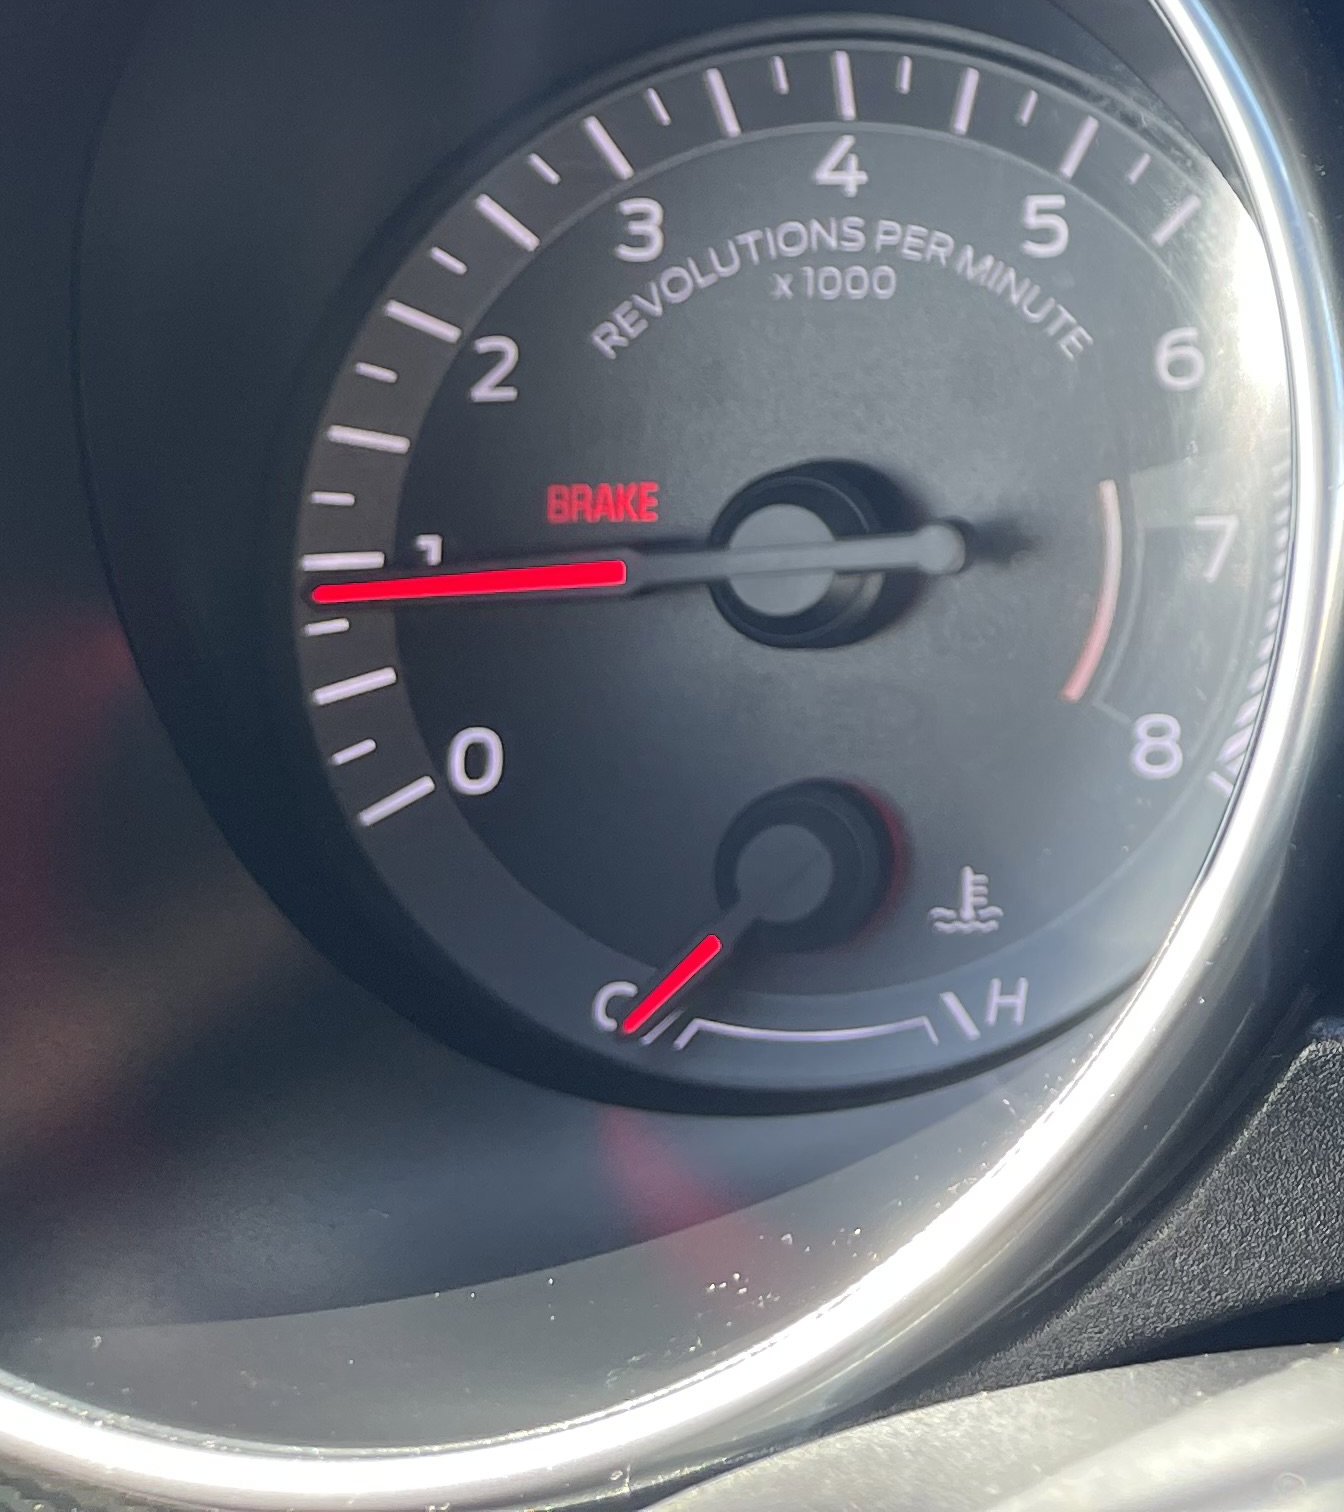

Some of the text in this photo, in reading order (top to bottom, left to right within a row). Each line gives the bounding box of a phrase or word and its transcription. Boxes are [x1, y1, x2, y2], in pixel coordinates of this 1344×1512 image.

[815, 135, 868, 196] 4
[615, 198, 664, 262] 3
[1022, 194, 1070, 258] 5
[591, 216, 1094, 362] REVOLUTIONS PER MINUTE
[470, 335, 520, 402] 2
[1155, 327, 1205, 388] 6
[547, 482, 660, 523] BRAKE
[1195, 514, 1239, 582] 7
[446, 727, 504, 794] 0
[1131, 712, 1183, 778] 8
[592, 981, 638, 1032] C
[985, 978, 1030, 1026] H
